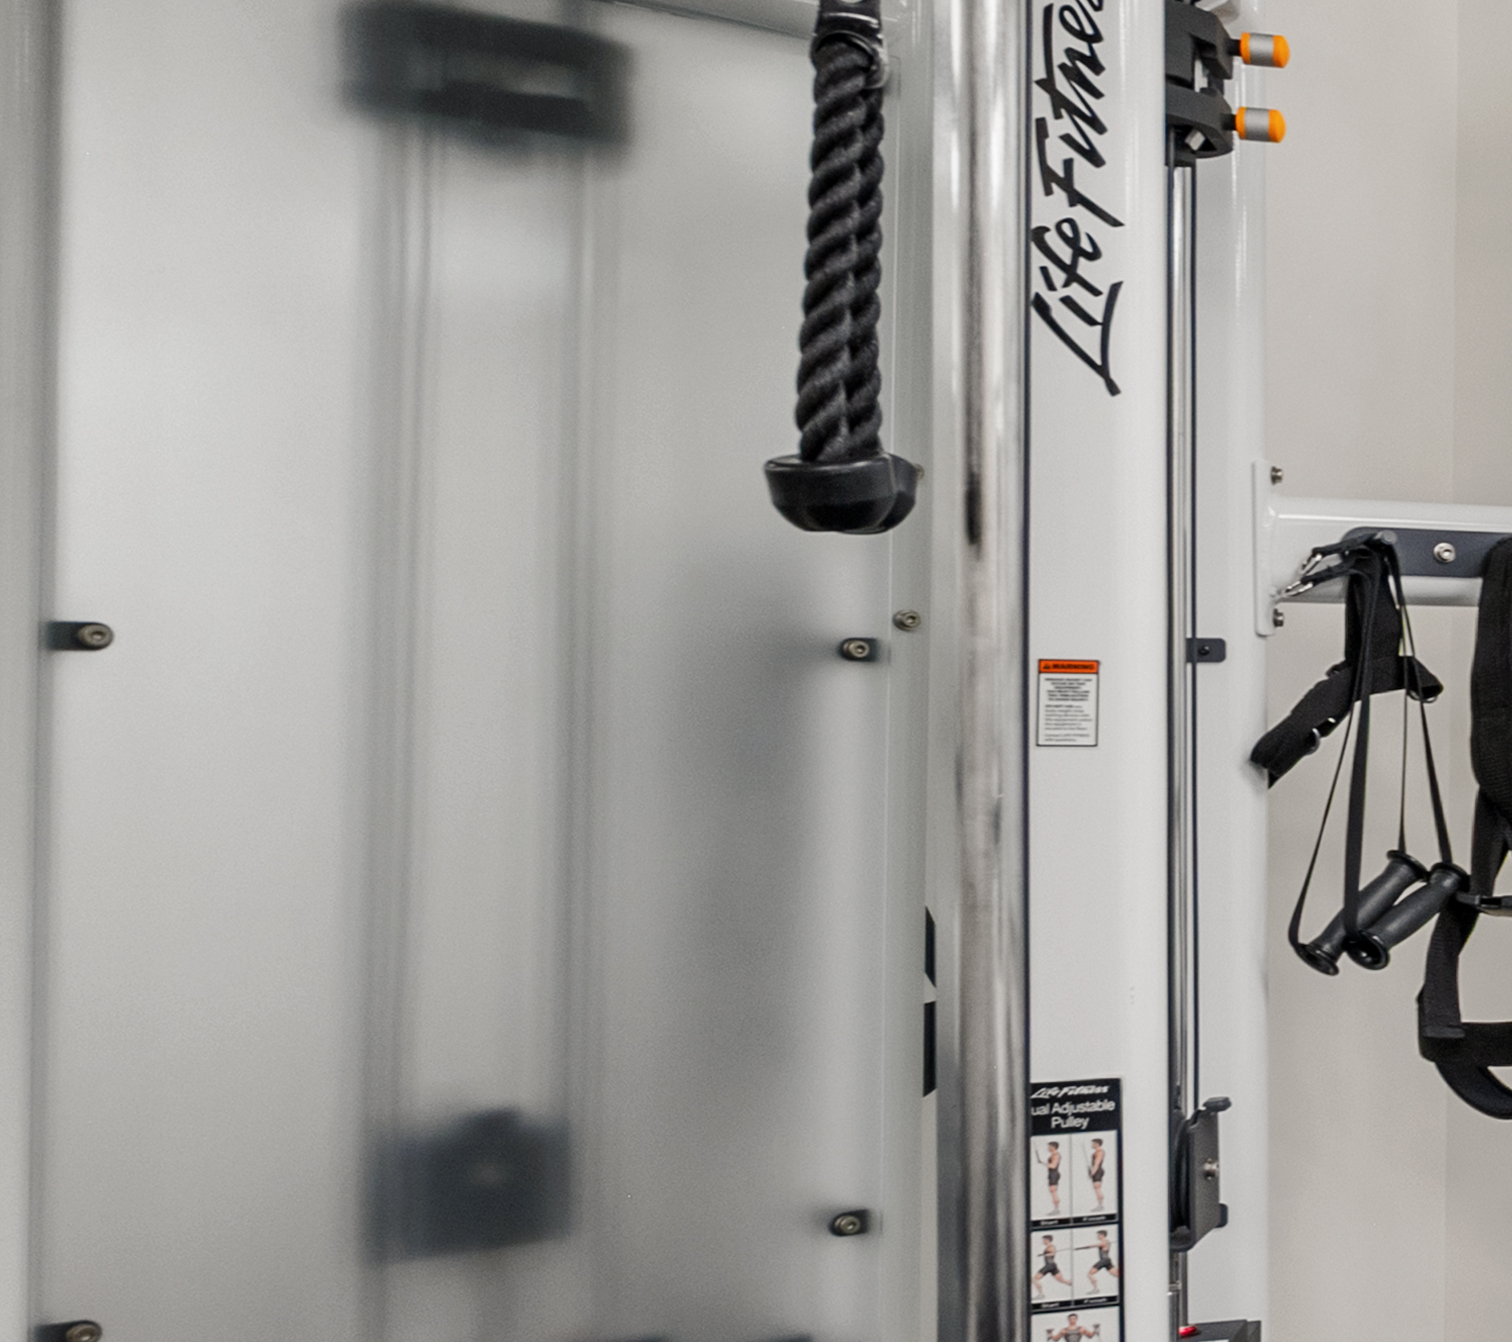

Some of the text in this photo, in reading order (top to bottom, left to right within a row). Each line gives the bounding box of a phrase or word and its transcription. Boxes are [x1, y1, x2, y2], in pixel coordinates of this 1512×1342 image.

[1031, 217, 1124, 396] Life
[1031, 1099, 1115, 1116] ual Adjustable
[1051, 1116, 1090, 1130] Pulley
